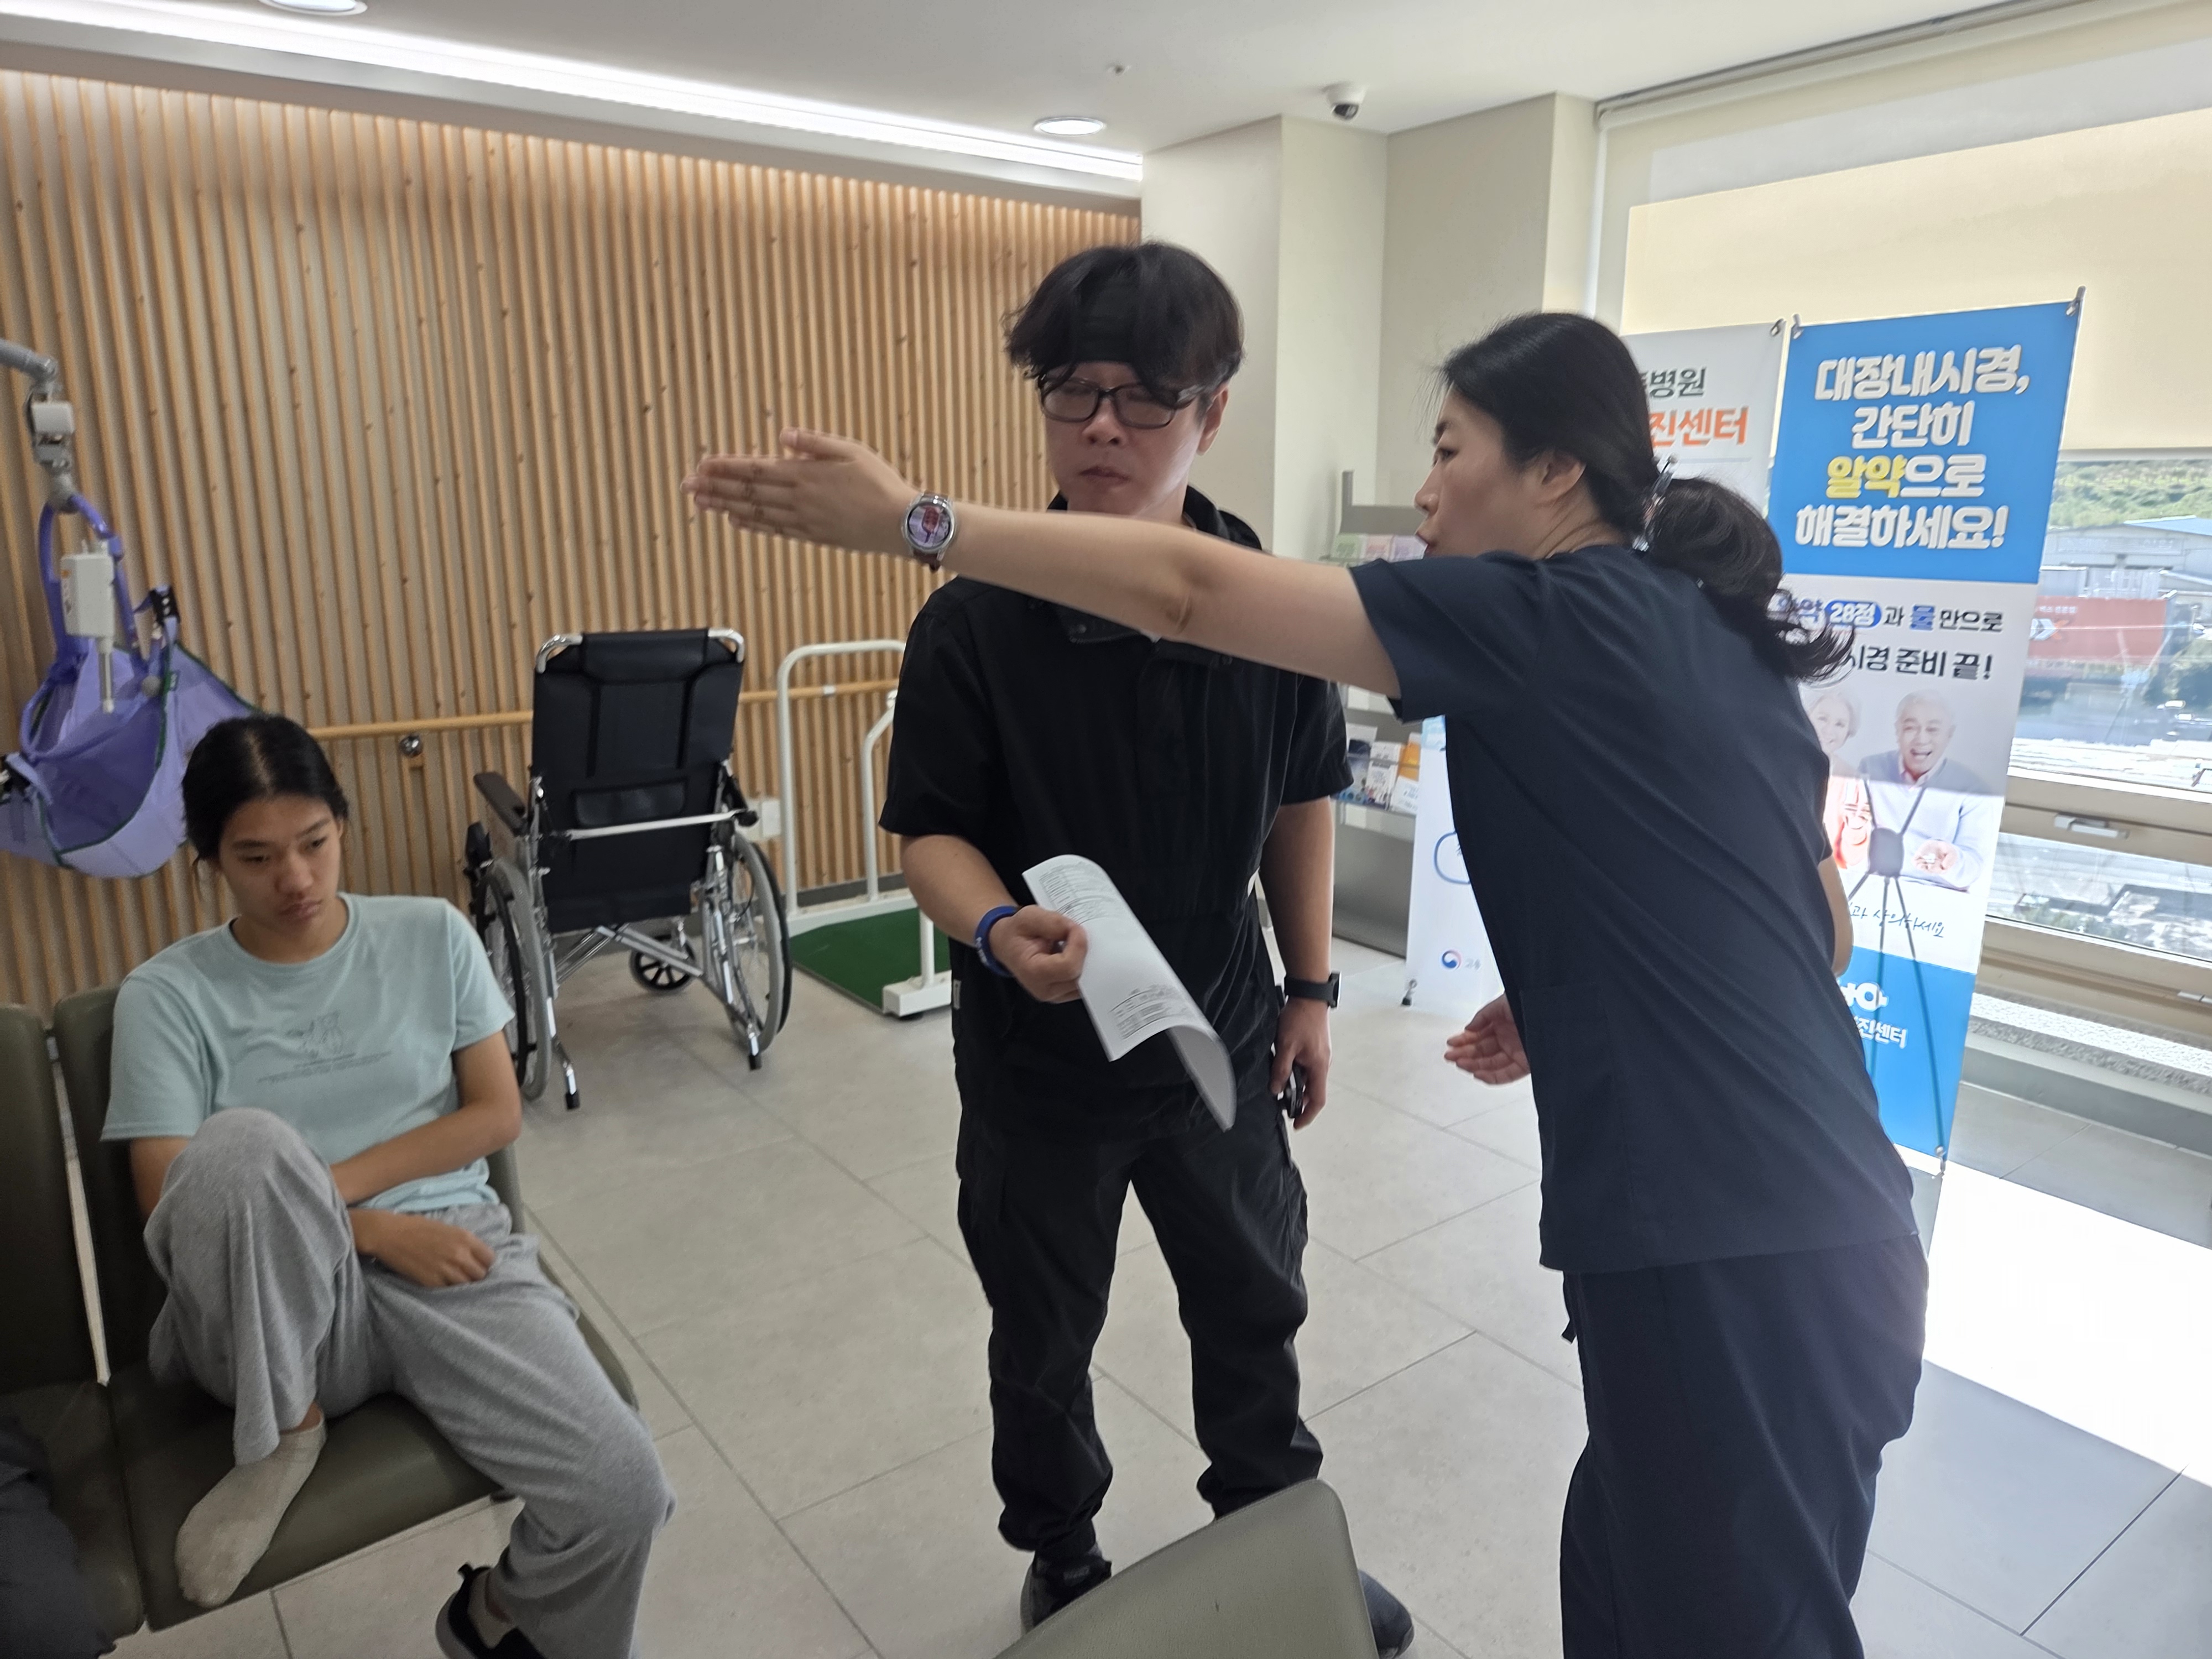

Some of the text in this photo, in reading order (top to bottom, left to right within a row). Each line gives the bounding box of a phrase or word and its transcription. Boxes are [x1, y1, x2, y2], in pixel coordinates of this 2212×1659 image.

[1642, 367, 1706, 398] 병원
[1814, 345, 2030, 401] 대장내시경,
[1650, 406, 1749, 447] 진센터
[1851, 400, 1975, 449] 간단히
[1826, 455, 1986, 498] 알약으로
[1795, 504, 2009, 549] 해결하세요!
[1829, 602, 1877, 627] 28정
[1939, 609, 2002, 632] 만으로
[1896, 647, 1947, 676] 준비
[1854, 1016, 1907, 1049] 진센터
